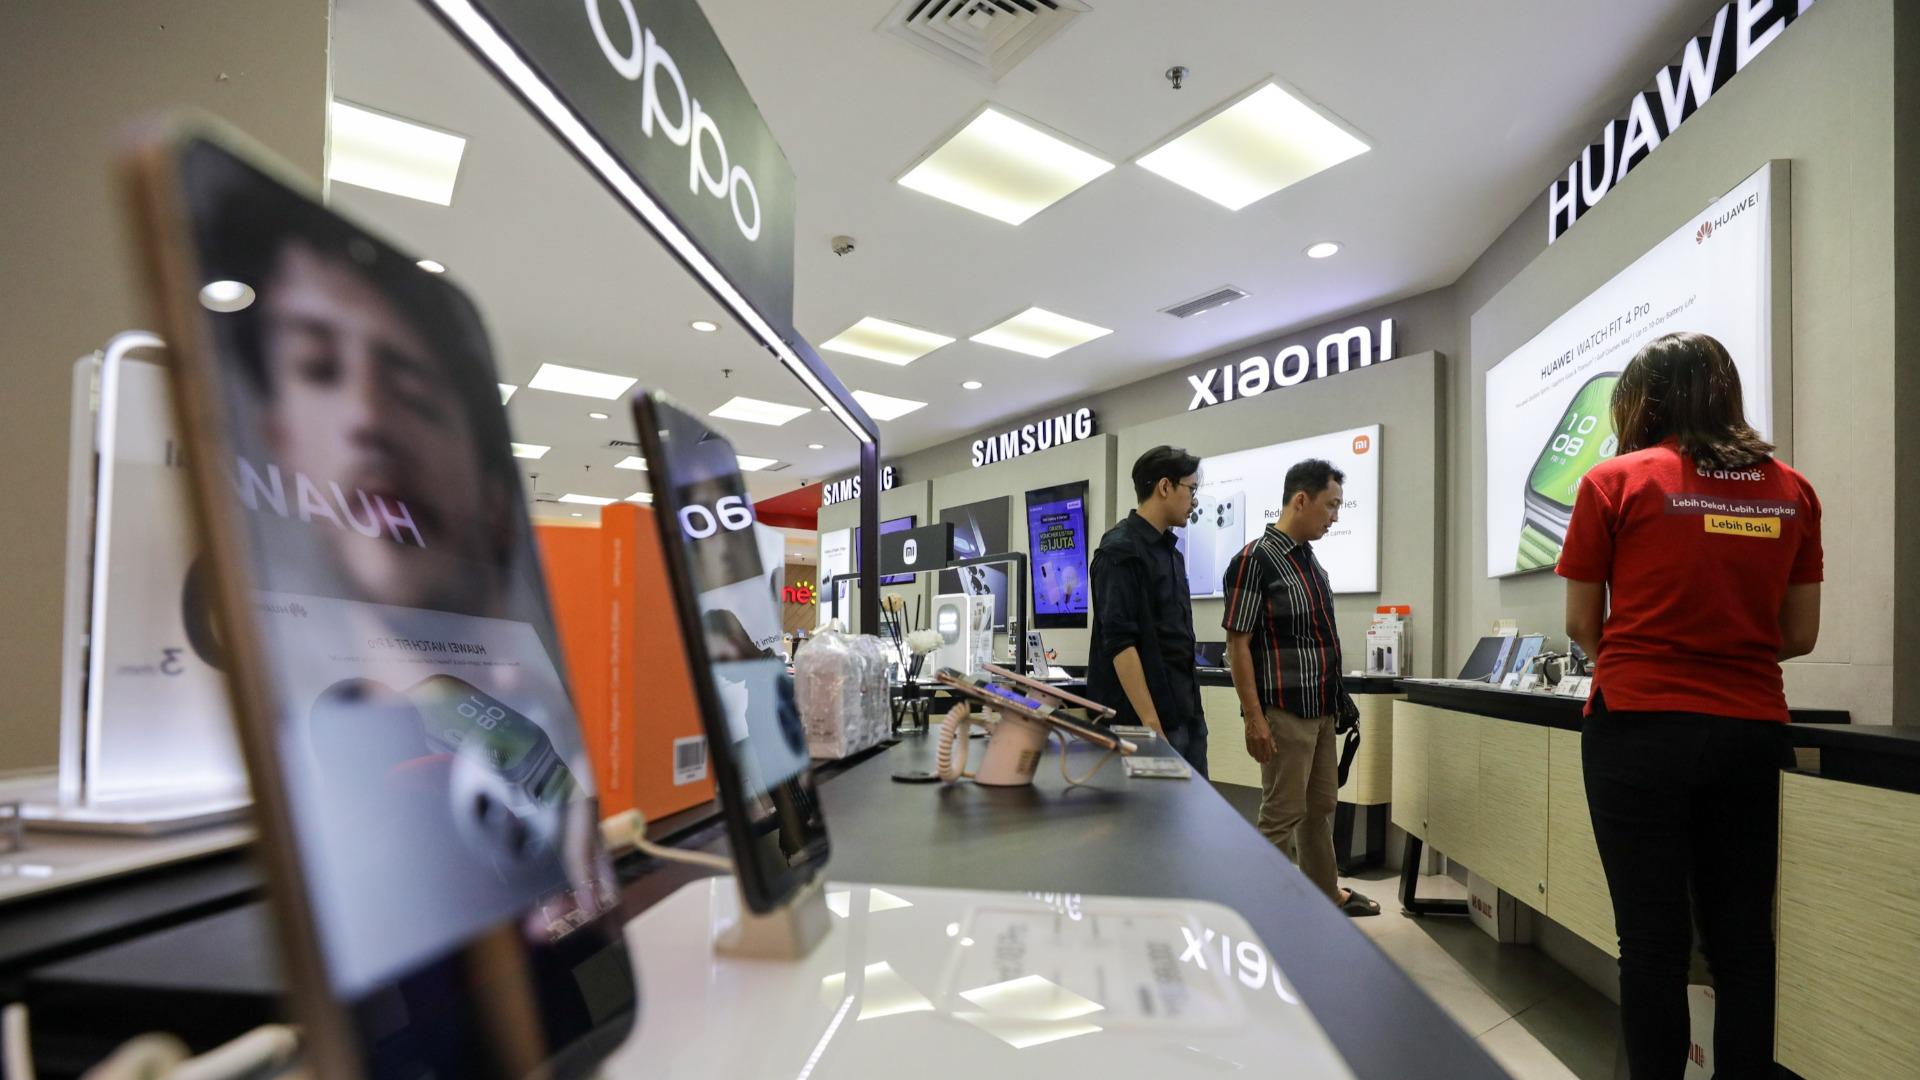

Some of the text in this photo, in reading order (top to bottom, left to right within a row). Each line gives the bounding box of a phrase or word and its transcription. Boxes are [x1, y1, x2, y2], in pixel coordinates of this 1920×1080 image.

[1549, 0, 1816, 247] HUAWE
[1714, 192, 1759, 230] HUAWEI
[1541, 348, 1574, 380] HUAWEI
[1577, 326, 1607, 356] WATCH
[1610, 316, 1623, 336] FIT
[1626, 311, 1632, 324] 4
[1634, 302, 1650, 320] Pro
[971, 408, 1092, 468] SAMSUNG
[1567, 413, 1597, 435] 10
[1552, 433, 1585, 457] 08
[823, 466, 893, 506] SAMSG
[1672, 499, 1796, 516] Lebih Dekat, Lebih Lengkap
[1711, 518, 1772, 533] Lebih Baik
